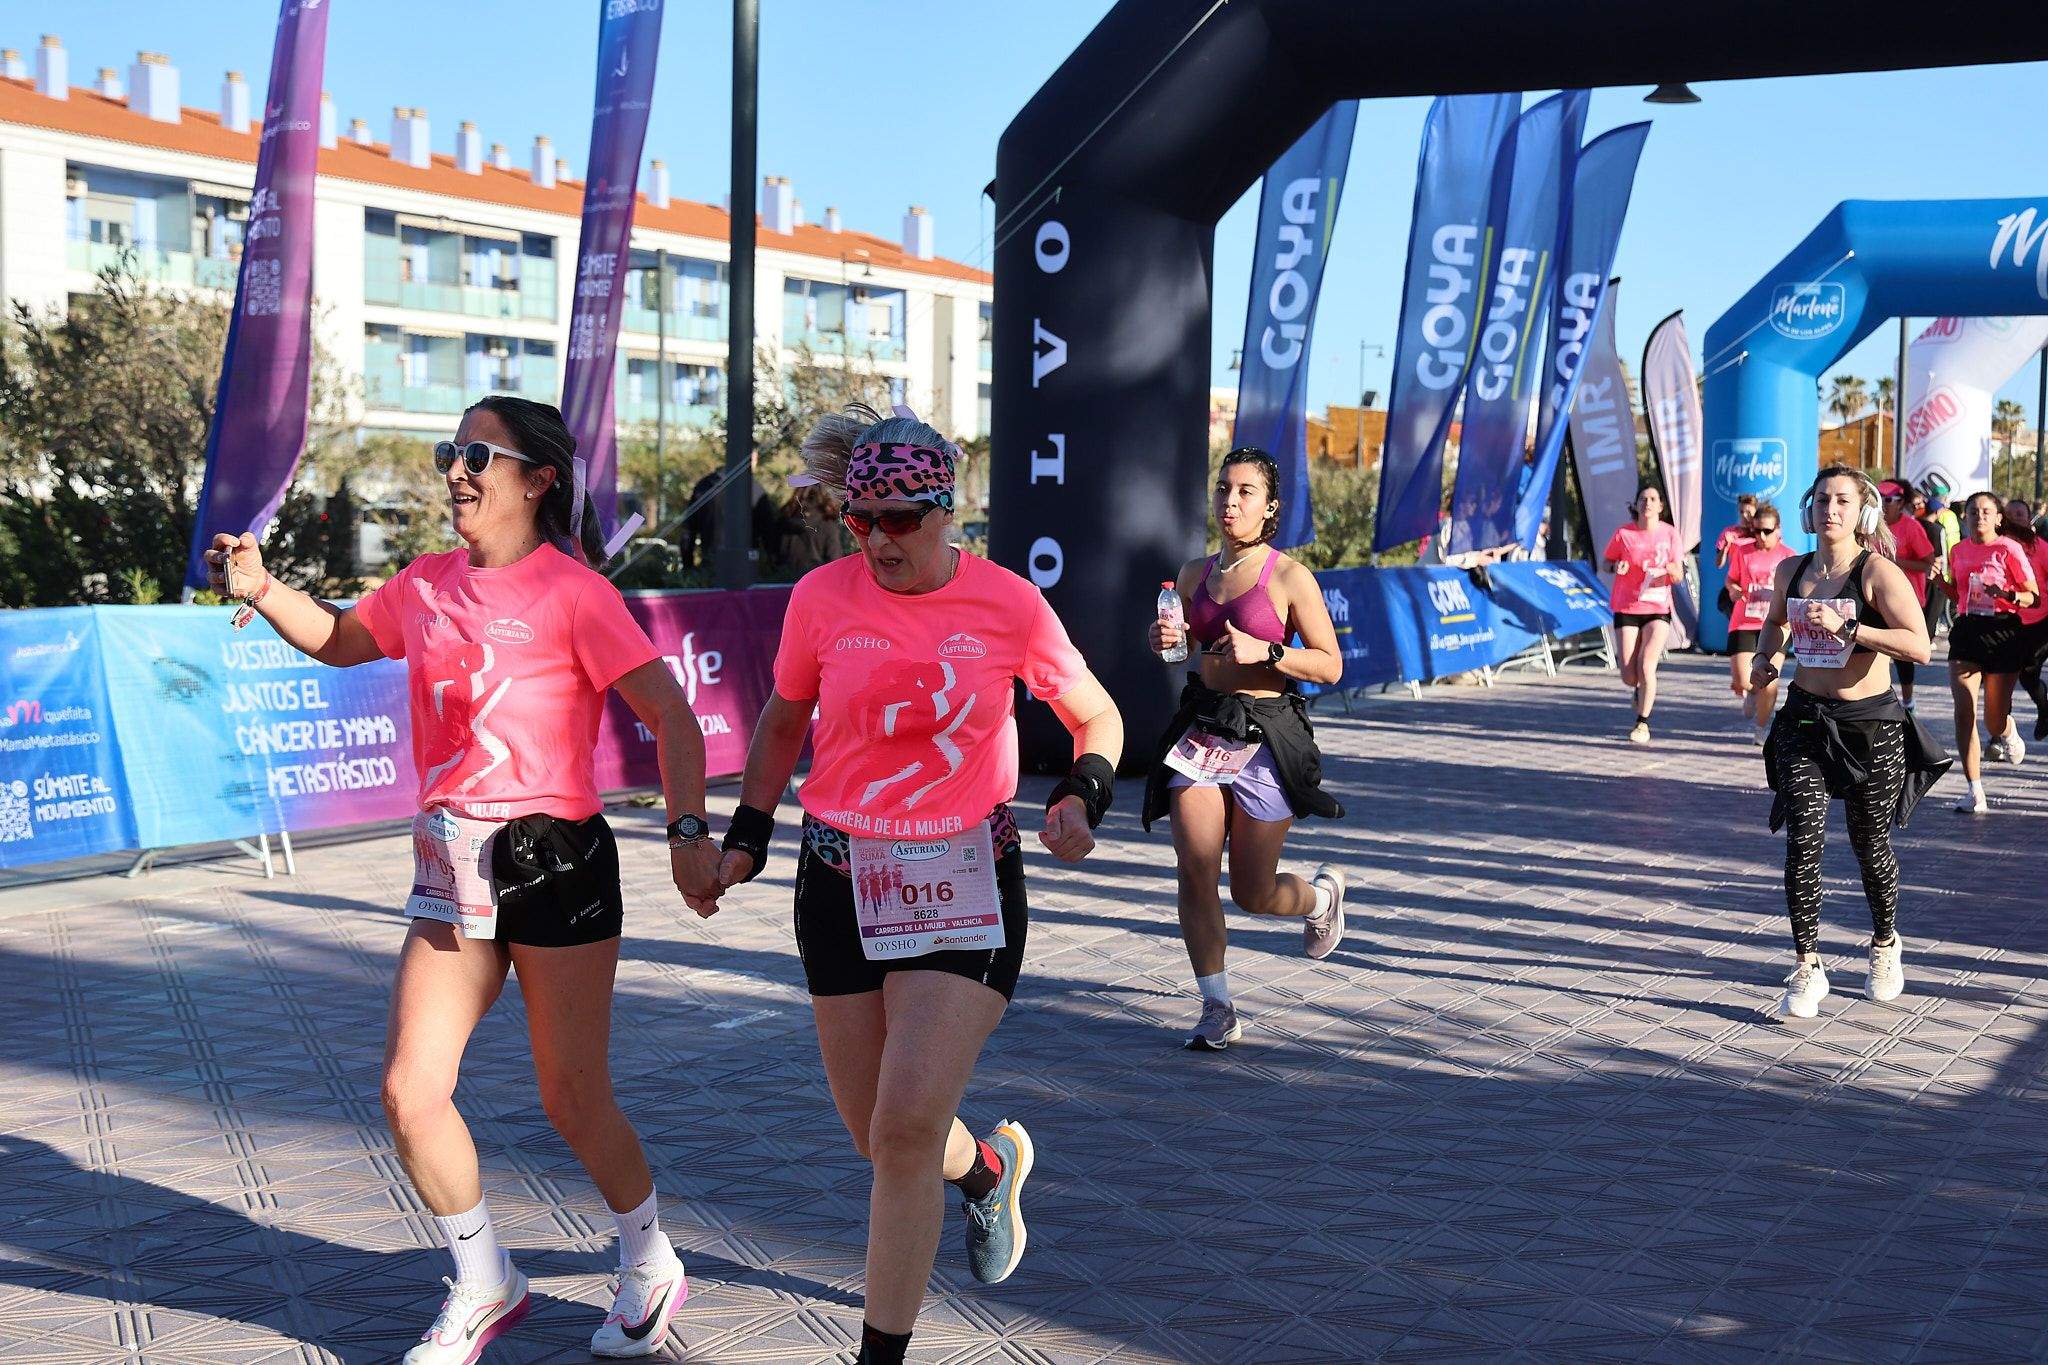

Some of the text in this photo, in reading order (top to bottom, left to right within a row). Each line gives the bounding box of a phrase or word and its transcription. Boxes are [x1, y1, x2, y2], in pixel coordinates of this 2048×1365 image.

[1261, 177, 1321, 370] GOYA
[1416, 223, 1478, 390] GOYA
[1475, 247, 1535, 401] GOYA
[1028, 220, 1070, 590] OLVO
[1577, 377, 1624, 476] IMR
[1657, 396, 1696, 477] IMR
[1716, 453, 1782, 487] Marlene
[836, 636, 891, 651] OYSHO
[222, 679, 329, 713] JUNTOS EL
[236, 715, 397, 755] CÁNCER DE MAMA
[1205, 748, 1232, 762] 016
[33, 771, 112, 801] SÚMATE AL
[267, 752, 397, 798] METASTÁSICO
[874, 818, 891, 835] DE
[895, 820, 910, 836] LA
[916, 816, 963, 836] MUJER
[860, 852, 886, 861] SUMA
[896, 843, 946, 856] ASTURIANA
[418, 900, 453, 915] OYSHO
[902, 881, 954, 905] 016
[875, 925, 903, 935] CARRERA
[905, 924, 914, 932] DE
[914, 923, 923, 931] LA
[924, 921, 946, 930] MUJER
[952, 918, 983, 927] VALENCIA
[914, 909, 939, 920] 8628
[875, 933, 988, 952] OYSHO Santander
